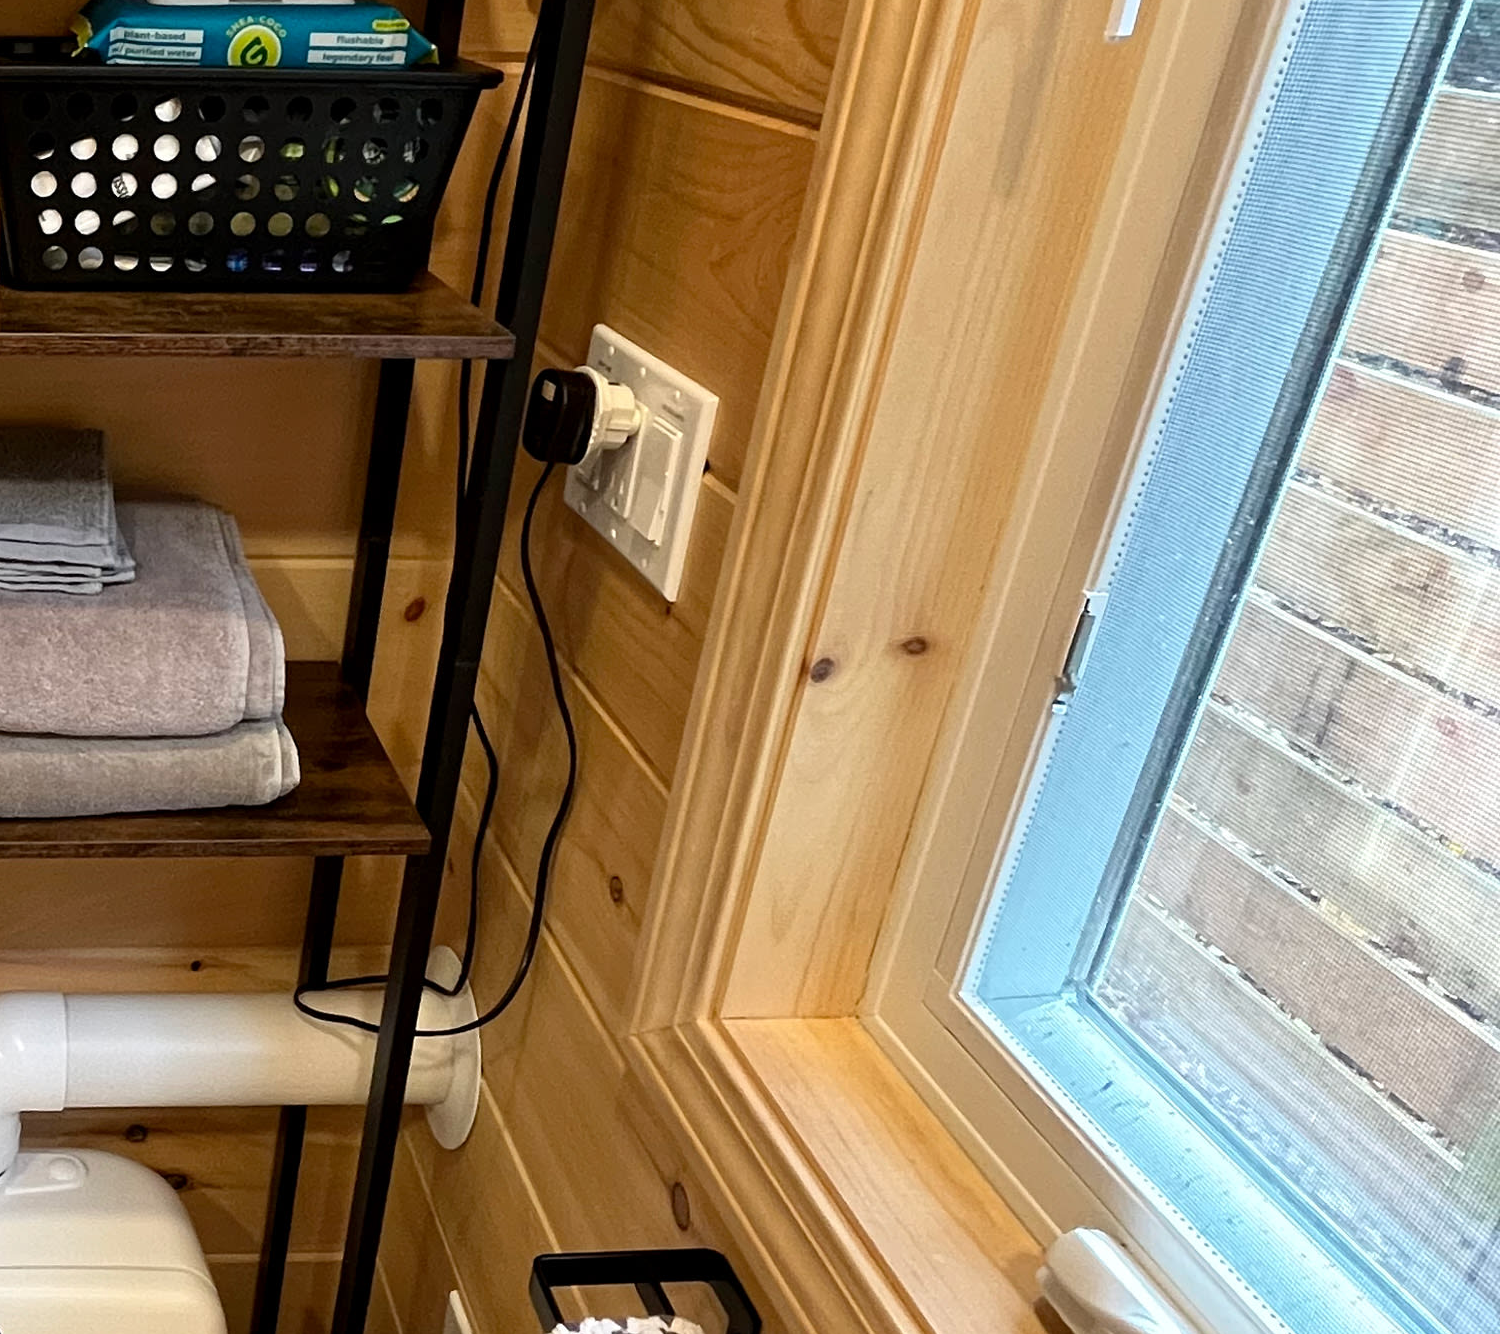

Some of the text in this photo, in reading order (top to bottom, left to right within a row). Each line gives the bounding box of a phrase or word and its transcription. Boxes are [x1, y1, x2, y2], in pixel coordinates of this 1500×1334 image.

[124, 29, 186, 41] plant-based
[336, 32, 385, 45] flushable
[125, 46, 165, 58] purified
[167, 48, 198, 58] water
[323, 52, 394, 64] legendary feel
